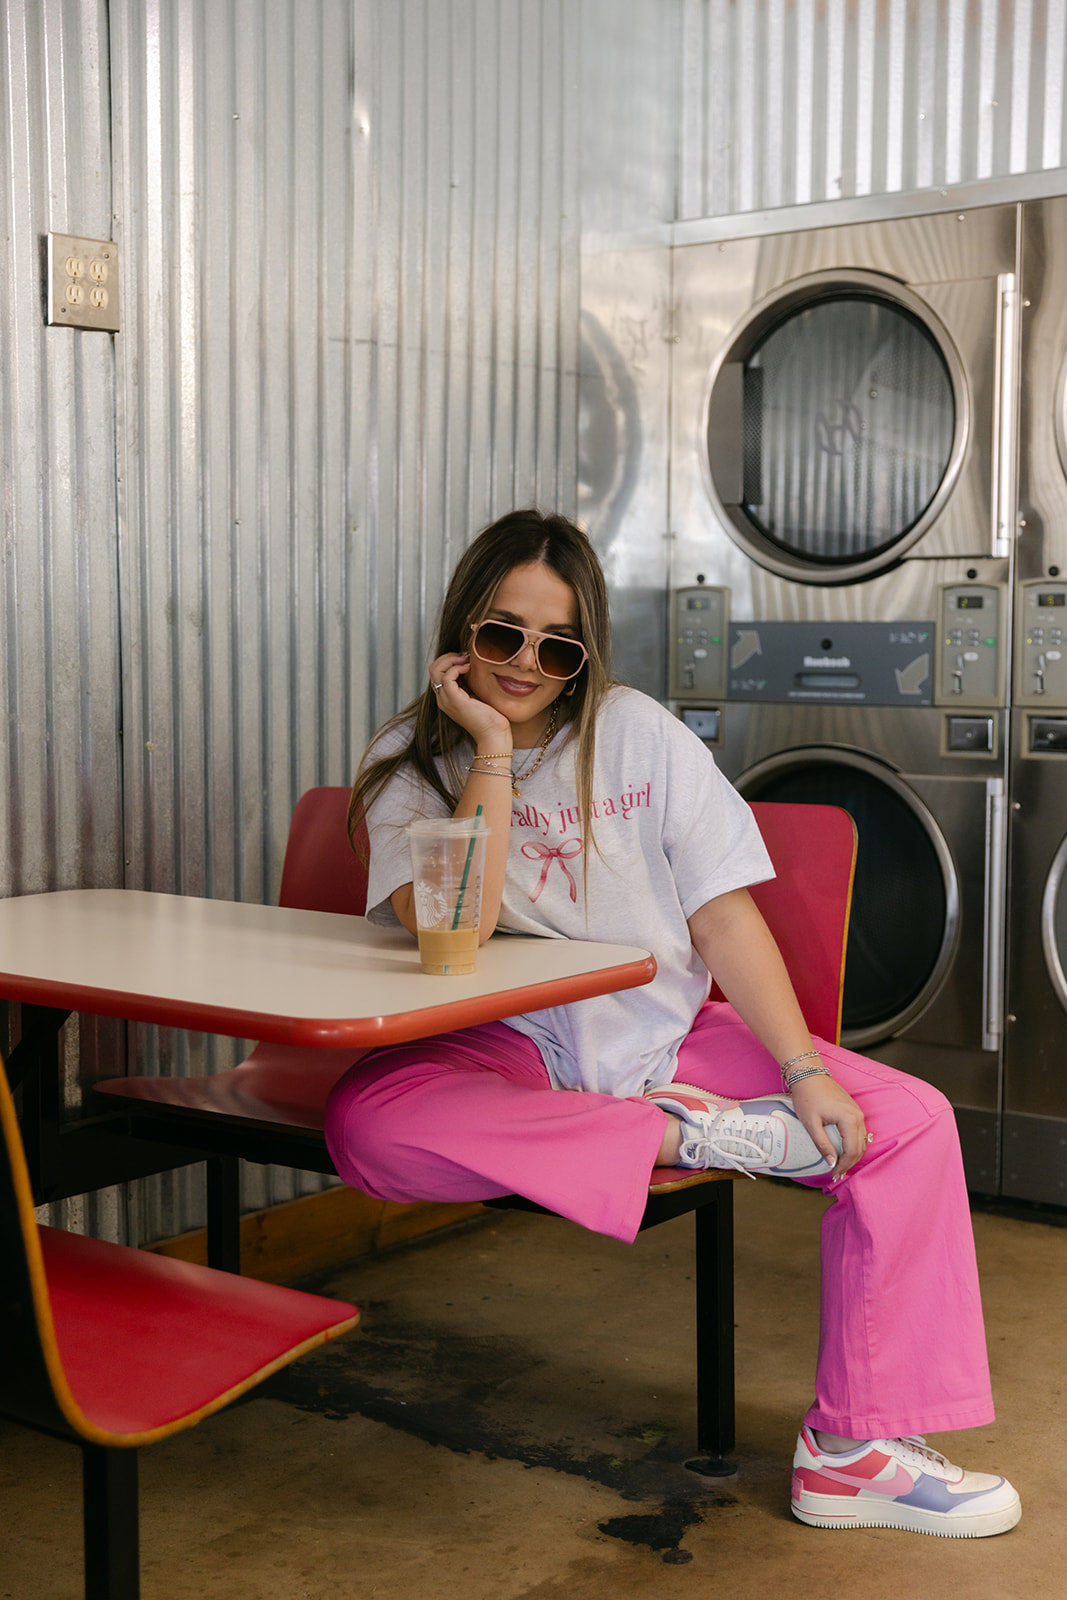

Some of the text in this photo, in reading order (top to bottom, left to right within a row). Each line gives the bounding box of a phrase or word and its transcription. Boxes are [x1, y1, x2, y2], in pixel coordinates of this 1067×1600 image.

[557, 800, 601, 834] jut
[602, 797, 618, 816] a
[621, 782, 651, 820] girl
